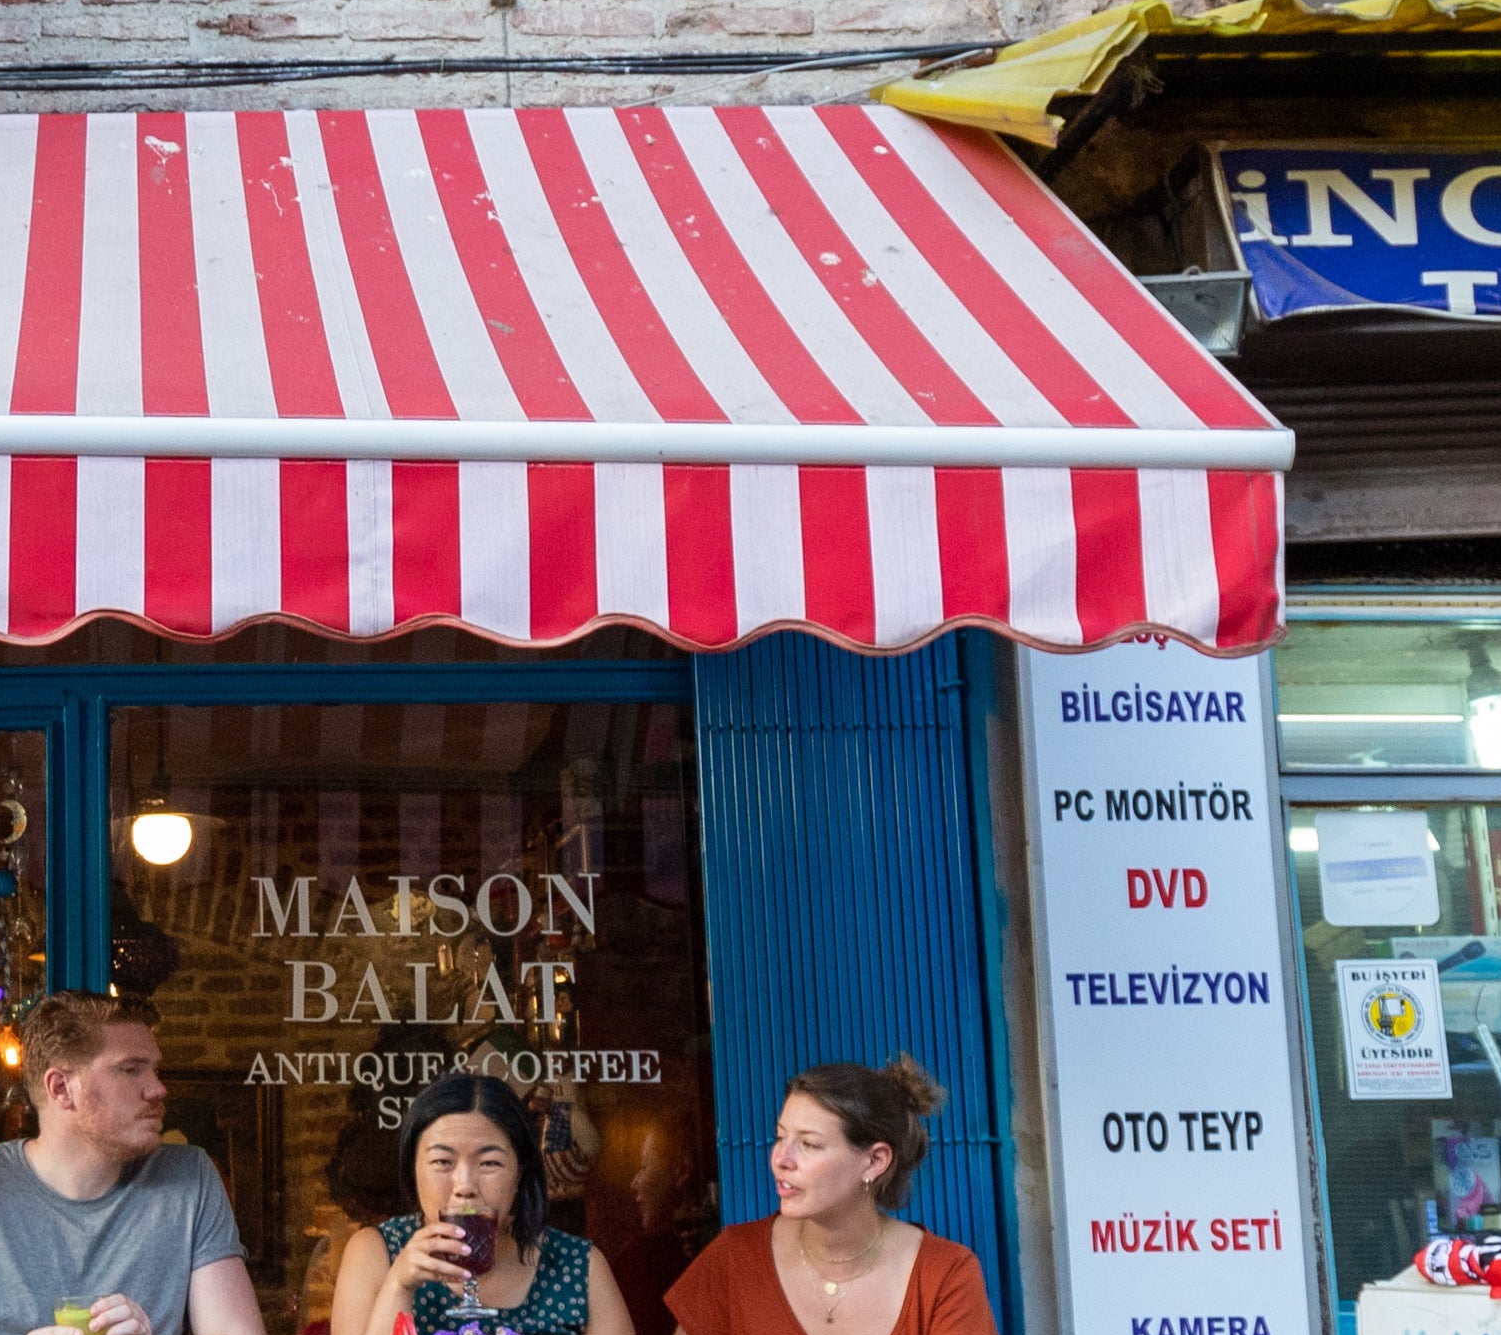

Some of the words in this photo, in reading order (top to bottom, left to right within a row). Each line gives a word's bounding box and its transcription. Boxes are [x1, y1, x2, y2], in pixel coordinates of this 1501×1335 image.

[1060, 683, 1247, 723] BİLGİSAYAR
[1054, 789, 1096, 822] PC
[1106, 781, 1254, 822] MONİTÖR
[250, 873, 601, 938] MAISON
[1126, 868, 1209, 909] DVD
[283, 960, 577, 1025] BALAT
[1066, 964, 1271, 1006] TELEVİZYON
[1351, 971, 1372, 982] BU
[1103, 1111, 1169, 1153] OTO
[1179, 1109, 1264, 1152] TEYP
[1091, 1211, 1200, 1254] MÜZİK
[1210, 1209, 1283, 1252] SETİ
